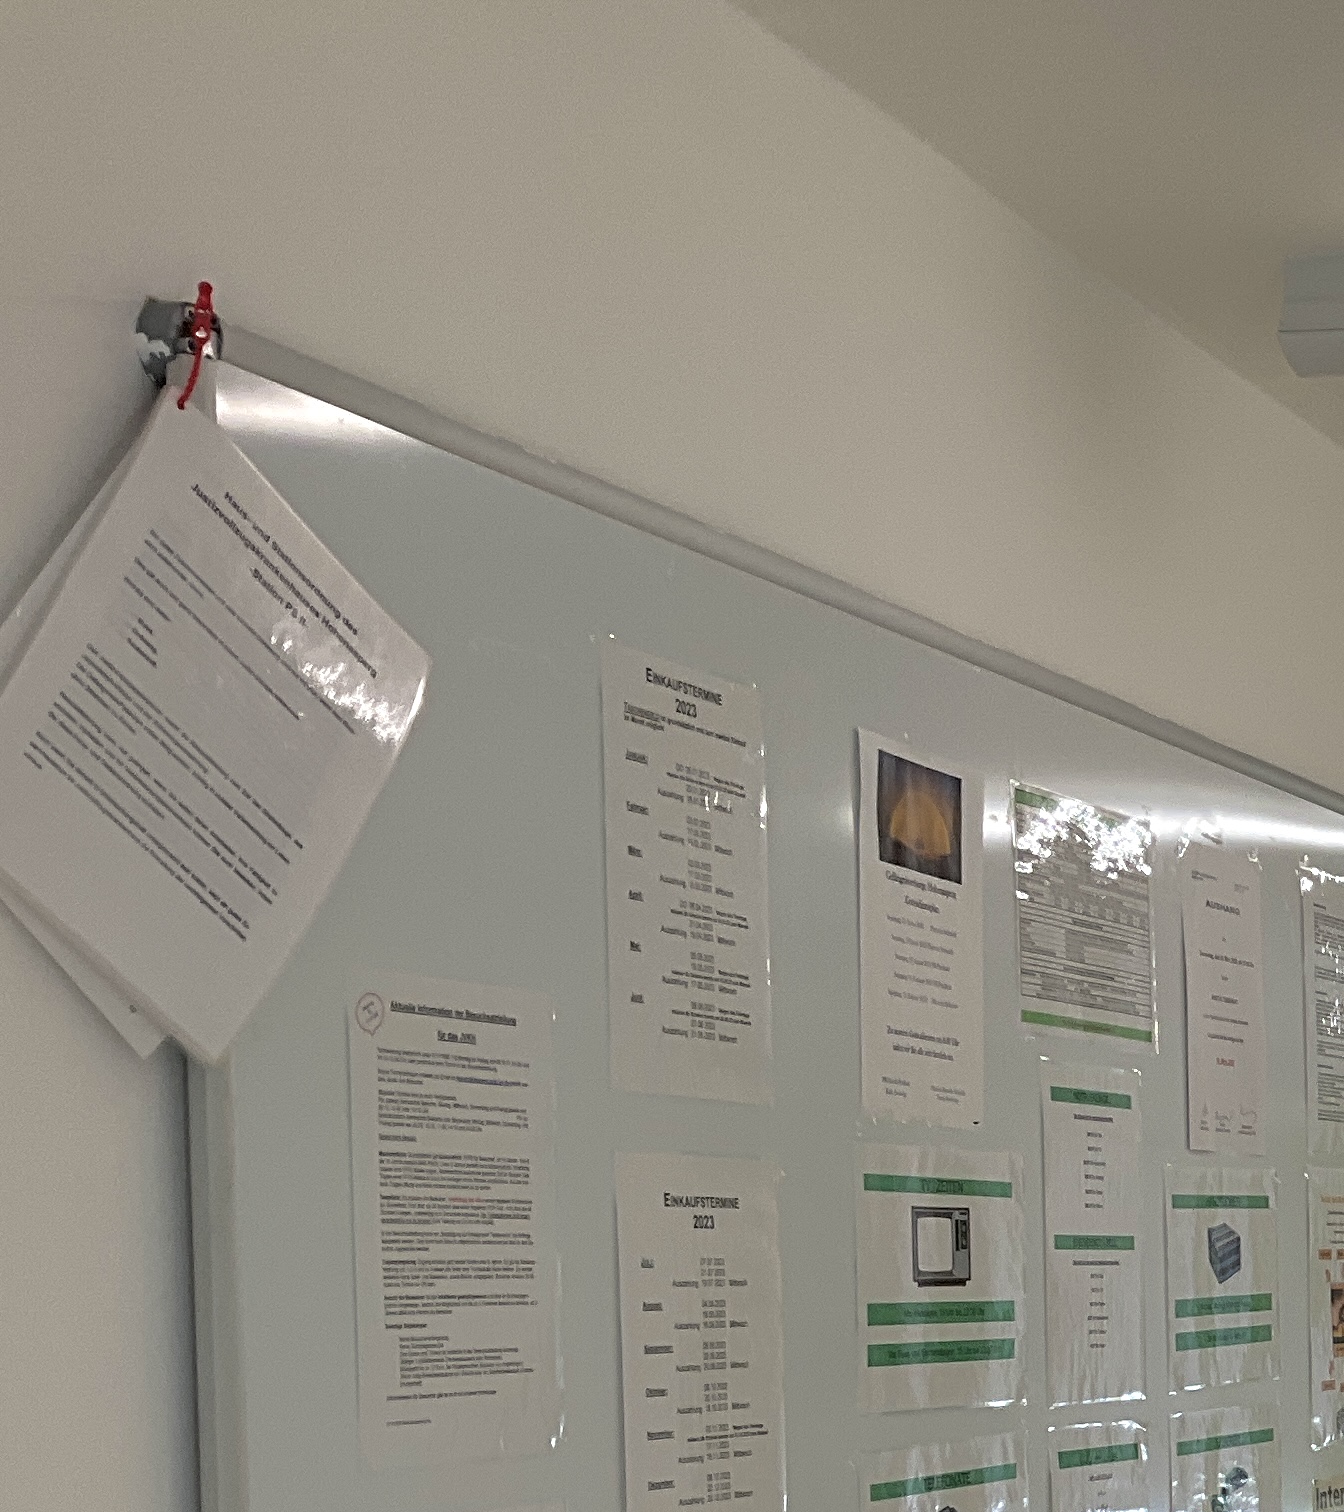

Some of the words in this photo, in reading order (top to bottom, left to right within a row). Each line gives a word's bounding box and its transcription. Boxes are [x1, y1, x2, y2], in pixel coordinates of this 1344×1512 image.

[252, 523, 271, 543] und
[271, 540, 341, 619] Stationsordnung
[675, 698, 697, 718] 2023
[663, 1191, 740, 1210] EINKAUFSTERMINE
[692, 1214, 715, 1230] 2023
